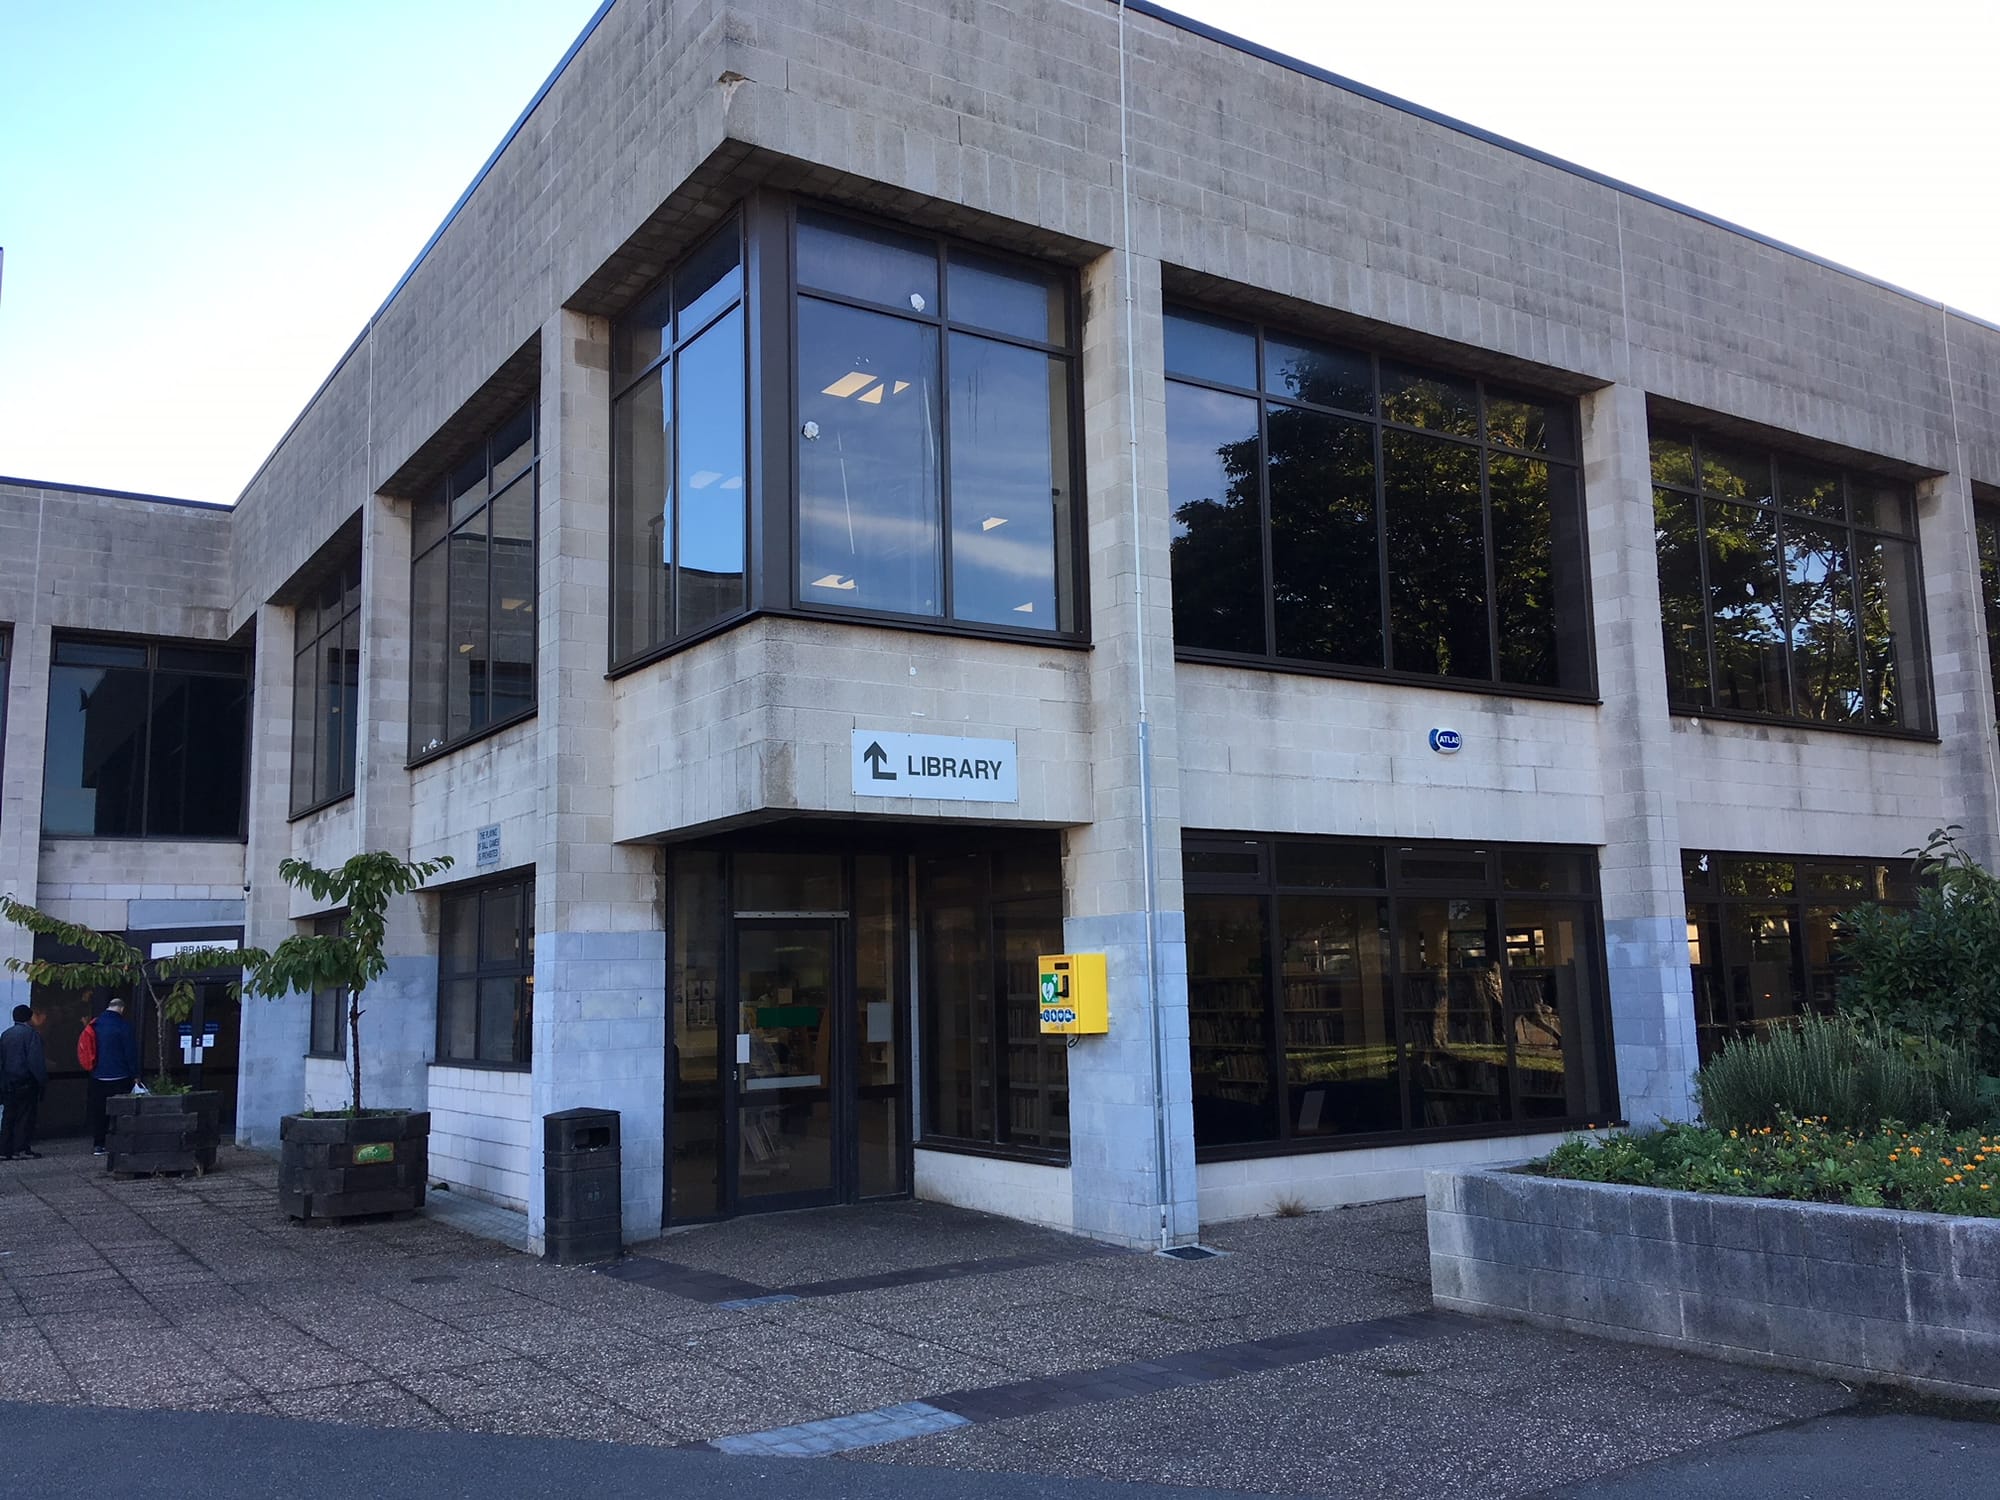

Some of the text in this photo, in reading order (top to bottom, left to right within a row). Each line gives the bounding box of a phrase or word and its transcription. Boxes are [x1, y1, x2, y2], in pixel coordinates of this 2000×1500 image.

[1440, 735, 1459, 744] ATLAS
[908, 755, 1002, 780] LIBRARY
[175, 945, 213, 955] LIBRARY
